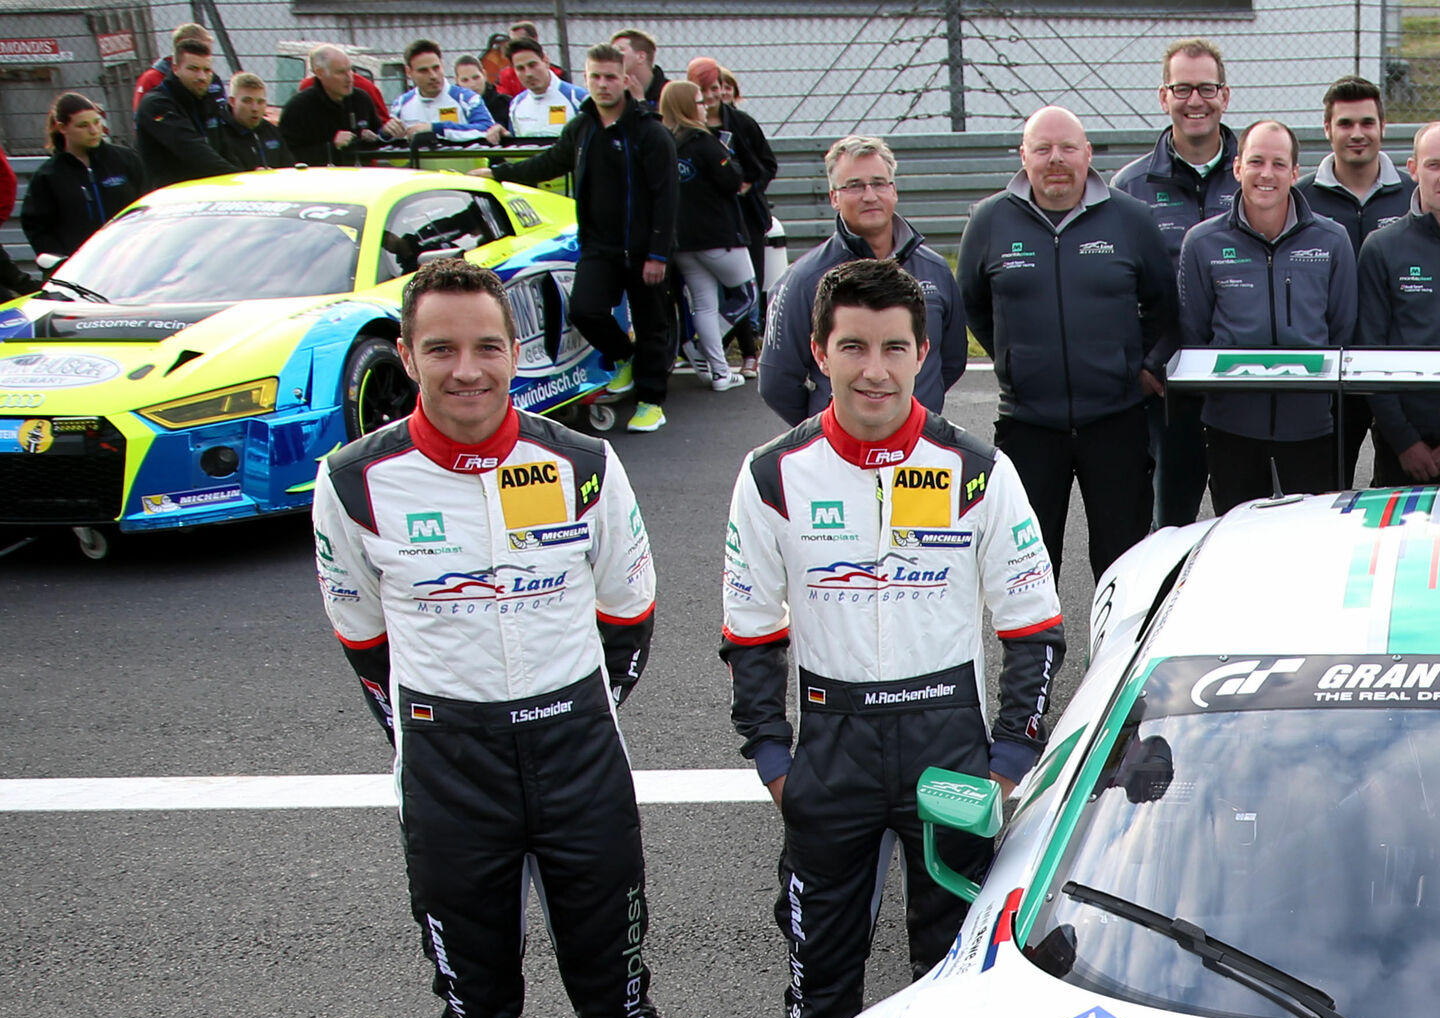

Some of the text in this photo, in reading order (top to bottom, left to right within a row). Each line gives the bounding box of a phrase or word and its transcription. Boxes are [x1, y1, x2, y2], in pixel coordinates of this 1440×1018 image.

[75, 319, 146, 330] customer
[873, 449, 905, 464] R8
[500, 464, 558, 489] ADAC
[894, 469, 950, 491] ADAC
[580, 473, 600, 504] P1
[965, 472, 987, 500] P1
[179, 488, 241, 504] MICHELIN
[541, 526, 589, 541] MICHELIN
[800, 533, 860, 543] montaplast
[921, 533, 972, 544] MICHELIN
[398, 545, 463, 557] montaplast
[512, 570, 567, 593] Land
[892, 566, 950, 582] Land
[417, 590, 567, 615] Motorsport
[808, 588, 948, 602] Motorsport
[1313, 691, 1353, 703] THE
[1358, 691, 1411, 704] REAL
[510, 700, 574, 724] T.Scheider
[427, 912, 458, 980] Land
